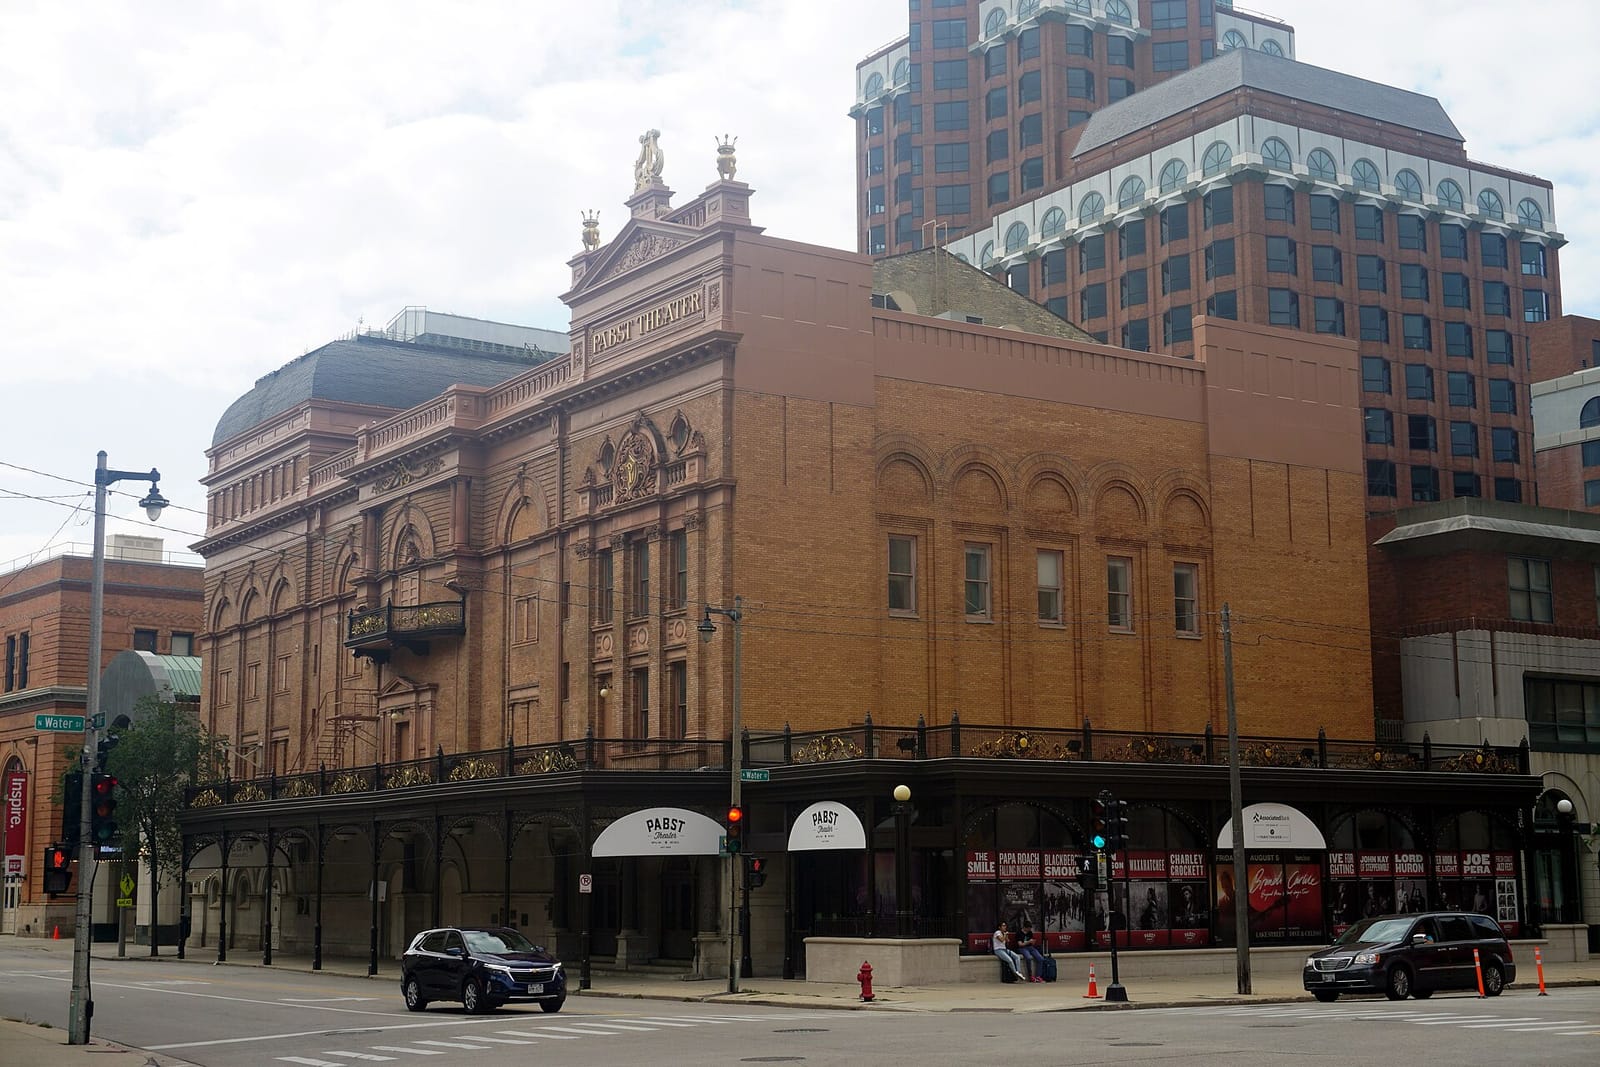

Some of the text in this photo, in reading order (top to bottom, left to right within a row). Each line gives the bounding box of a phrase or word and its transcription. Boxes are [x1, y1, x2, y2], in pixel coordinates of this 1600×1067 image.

[592, 292, 701, 355] PABST THEATER
[45, 717, 73, 729] Water
[746, 771, 762, 780] Water
[9, 778, 26, 828] Inspire.
[812, 810, 839, 826] PABST
[646, 817, 686, 833] PABST
[653, 832, 677, 840] Theater
[974, 852, 988, 862] THE
[999, 852, 1040, 865] PAPA ROACH
[1170, 853, 1203, 865] CHARLEY
[1329, 853, 1344, 864] IVE
[1360, 855, 1389, 863] JOHN KAY
[1394, 853, 1424, 863] LORD
[1463, 853, 1491, 865] JOE
[967, 861, 996, 873] SMILE
[1170, 865, 1204, 876] CROCKETT
[1329, 863, 1355, 875] GHTING
[1395, 863, 1425, 873] HURON
[1441, 865, 1458, 873] LIGHT
[1463, 865, 1491, 874] PERA
